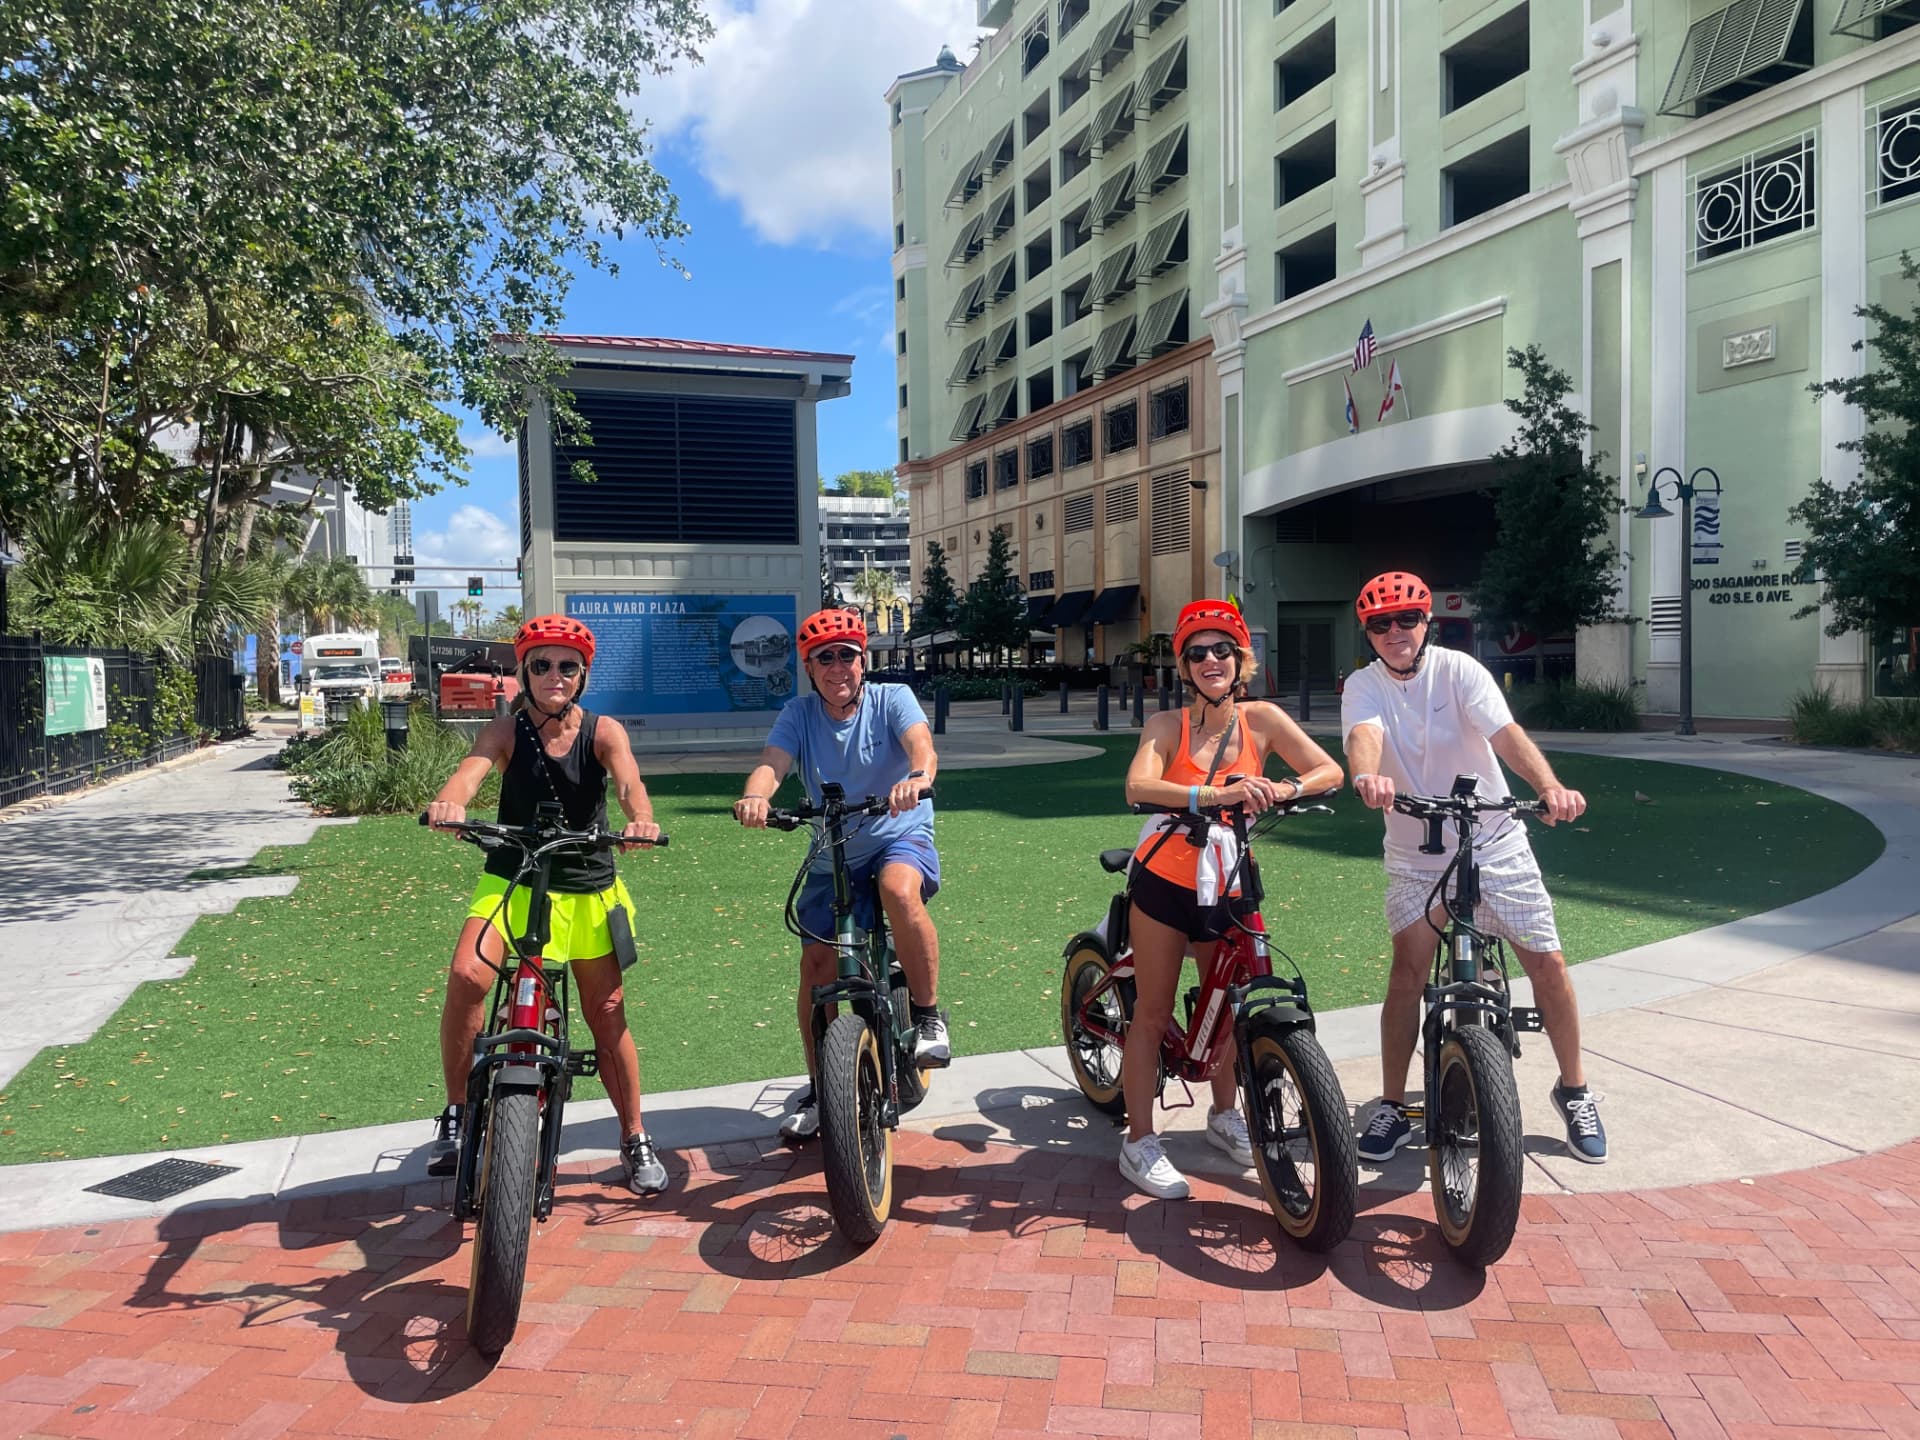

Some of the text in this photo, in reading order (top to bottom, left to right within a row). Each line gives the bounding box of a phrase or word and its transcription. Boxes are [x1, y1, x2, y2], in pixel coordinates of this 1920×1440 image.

[1712, 574, 1779, 589] SAGAMORE
[1781, 573, 1814, 586] RO
[1709, 592, 1731, 604] 420
[1756, 591, 1764, 603] 6
[1766, 590, 1793, 602] AVE.
[571, 602, 686, 614] LAURA WARD PLAZA
